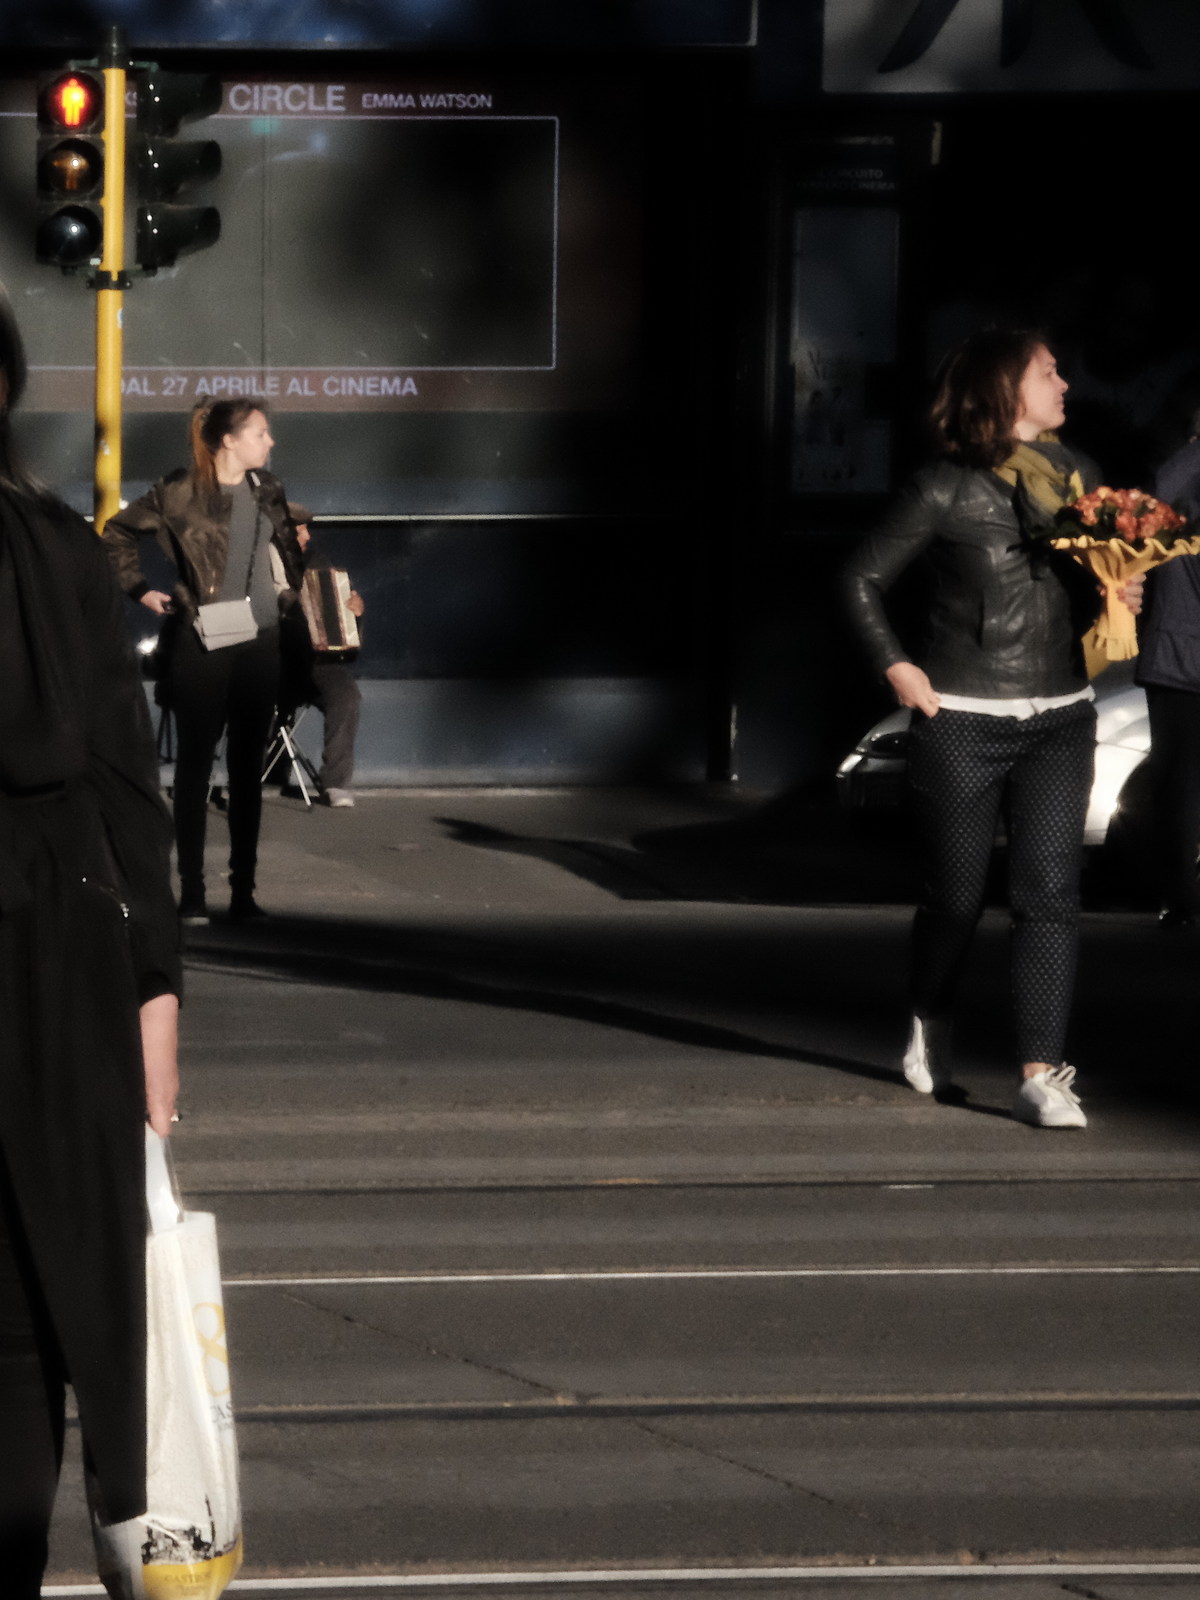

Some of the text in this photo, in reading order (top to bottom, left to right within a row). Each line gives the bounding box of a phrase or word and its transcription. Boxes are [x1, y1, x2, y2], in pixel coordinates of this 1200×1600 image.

[228, 84, 492, 112] CIRCLE EMMA WATSON
[162, 376, 188, 396] 27
[195, 376, 280, 396] APRILE
[287, 376, 316, 396] AL
[322, 376, 419, 396] CINEMA
